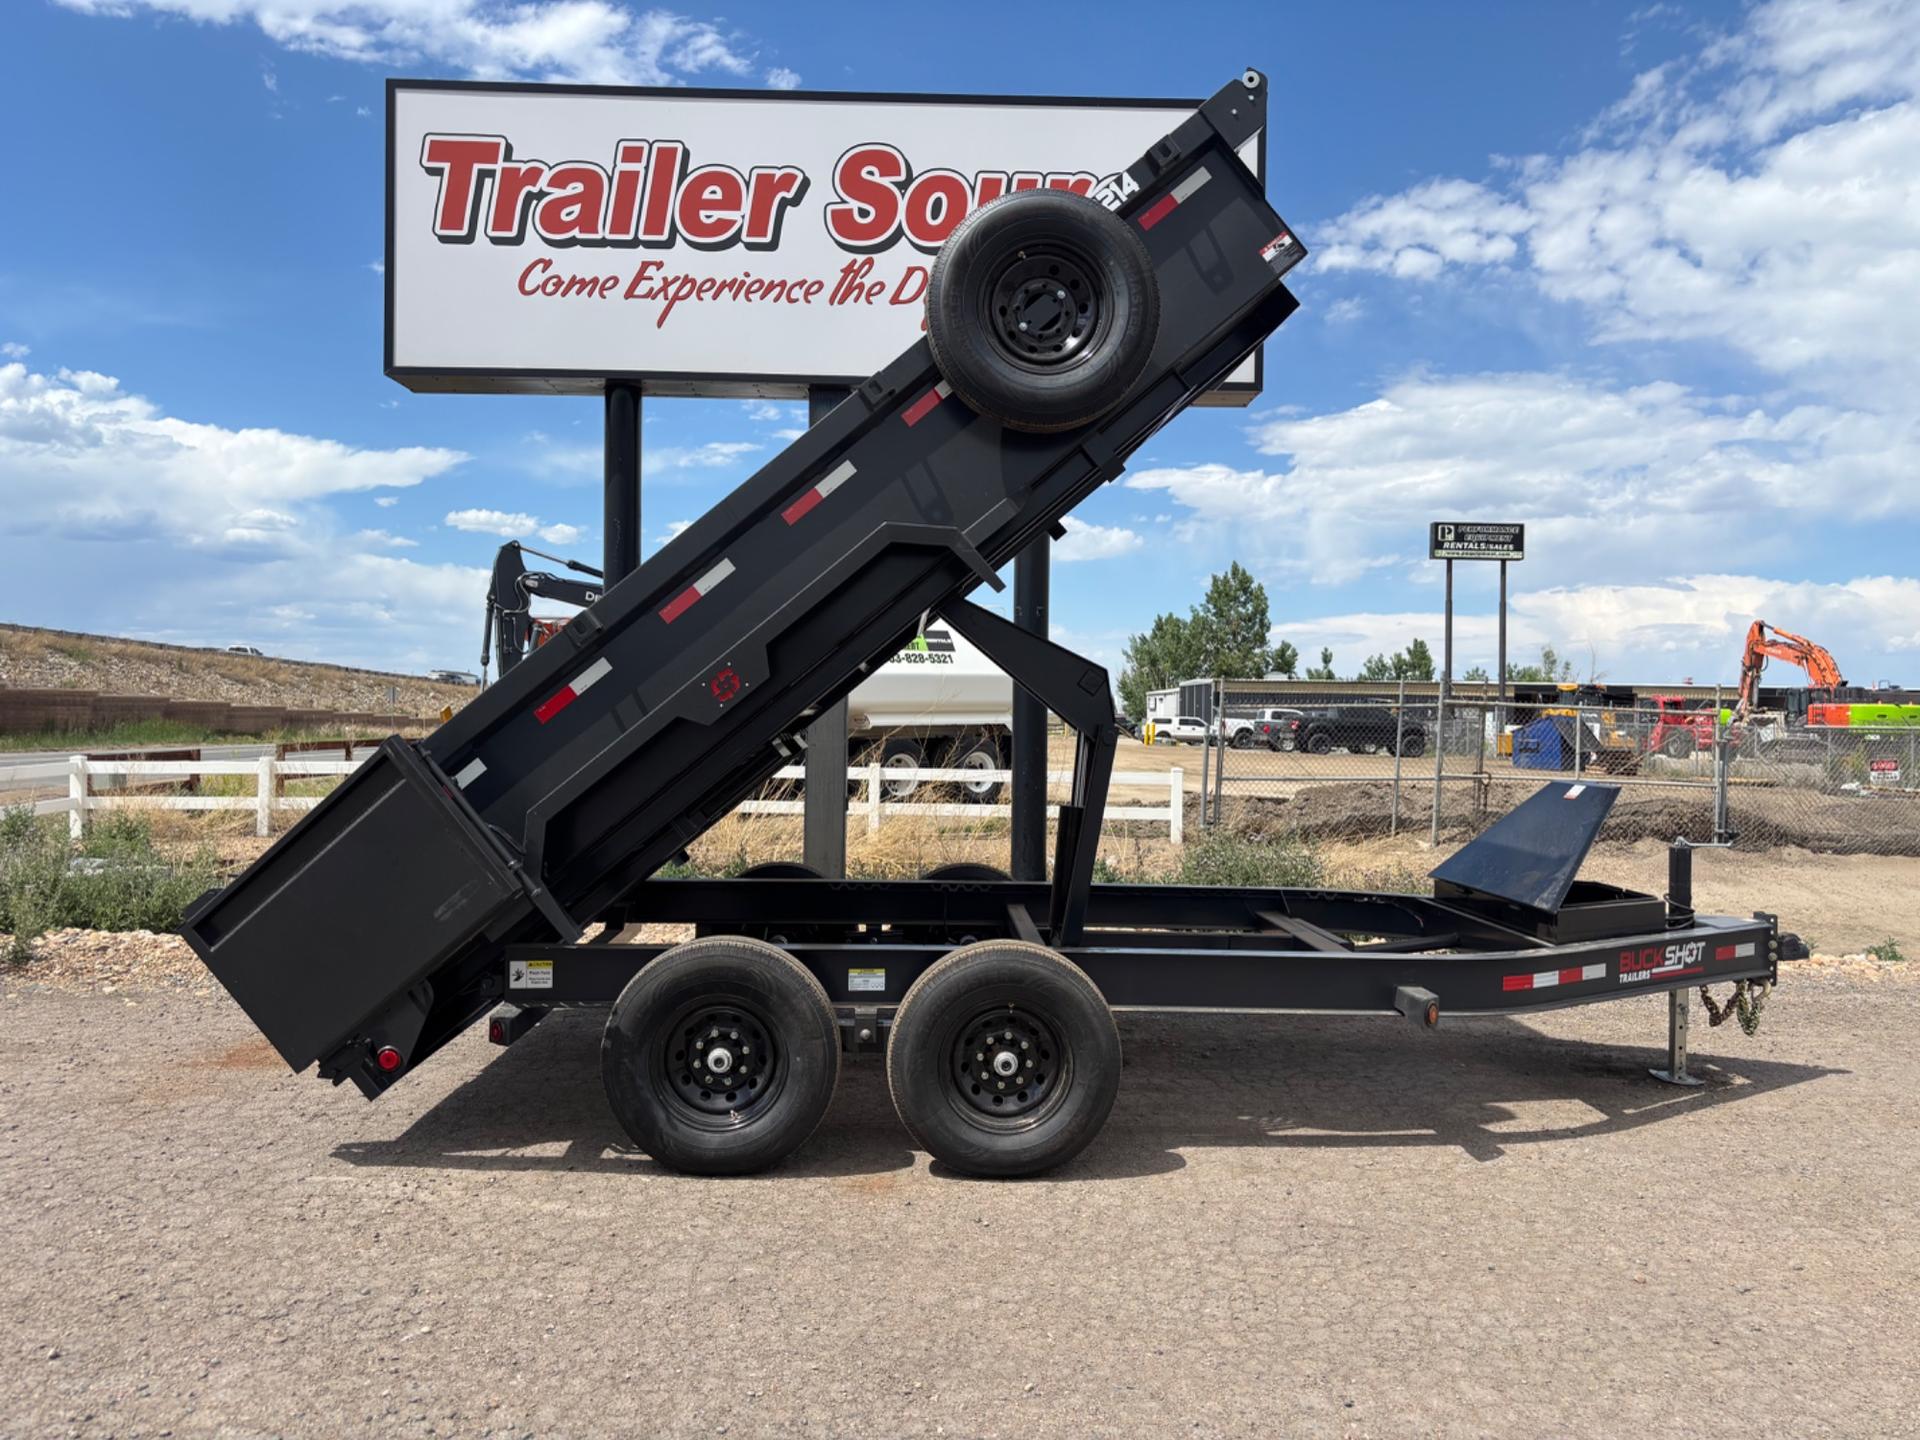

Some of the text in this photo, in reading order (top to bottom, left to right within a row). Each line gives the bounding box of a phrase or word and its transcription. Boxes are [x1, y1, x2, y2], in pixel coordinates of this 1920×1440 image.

[420, 132, 1121, 256] Trailer Sour
[1093, 171, 1140, 212] 214
[518, 258, 620, 300] Come
[623, 260, 825, 329] Experience
[829, 256, 886, 306] the
[1619, 969, 1651, 984] TRAILERS
